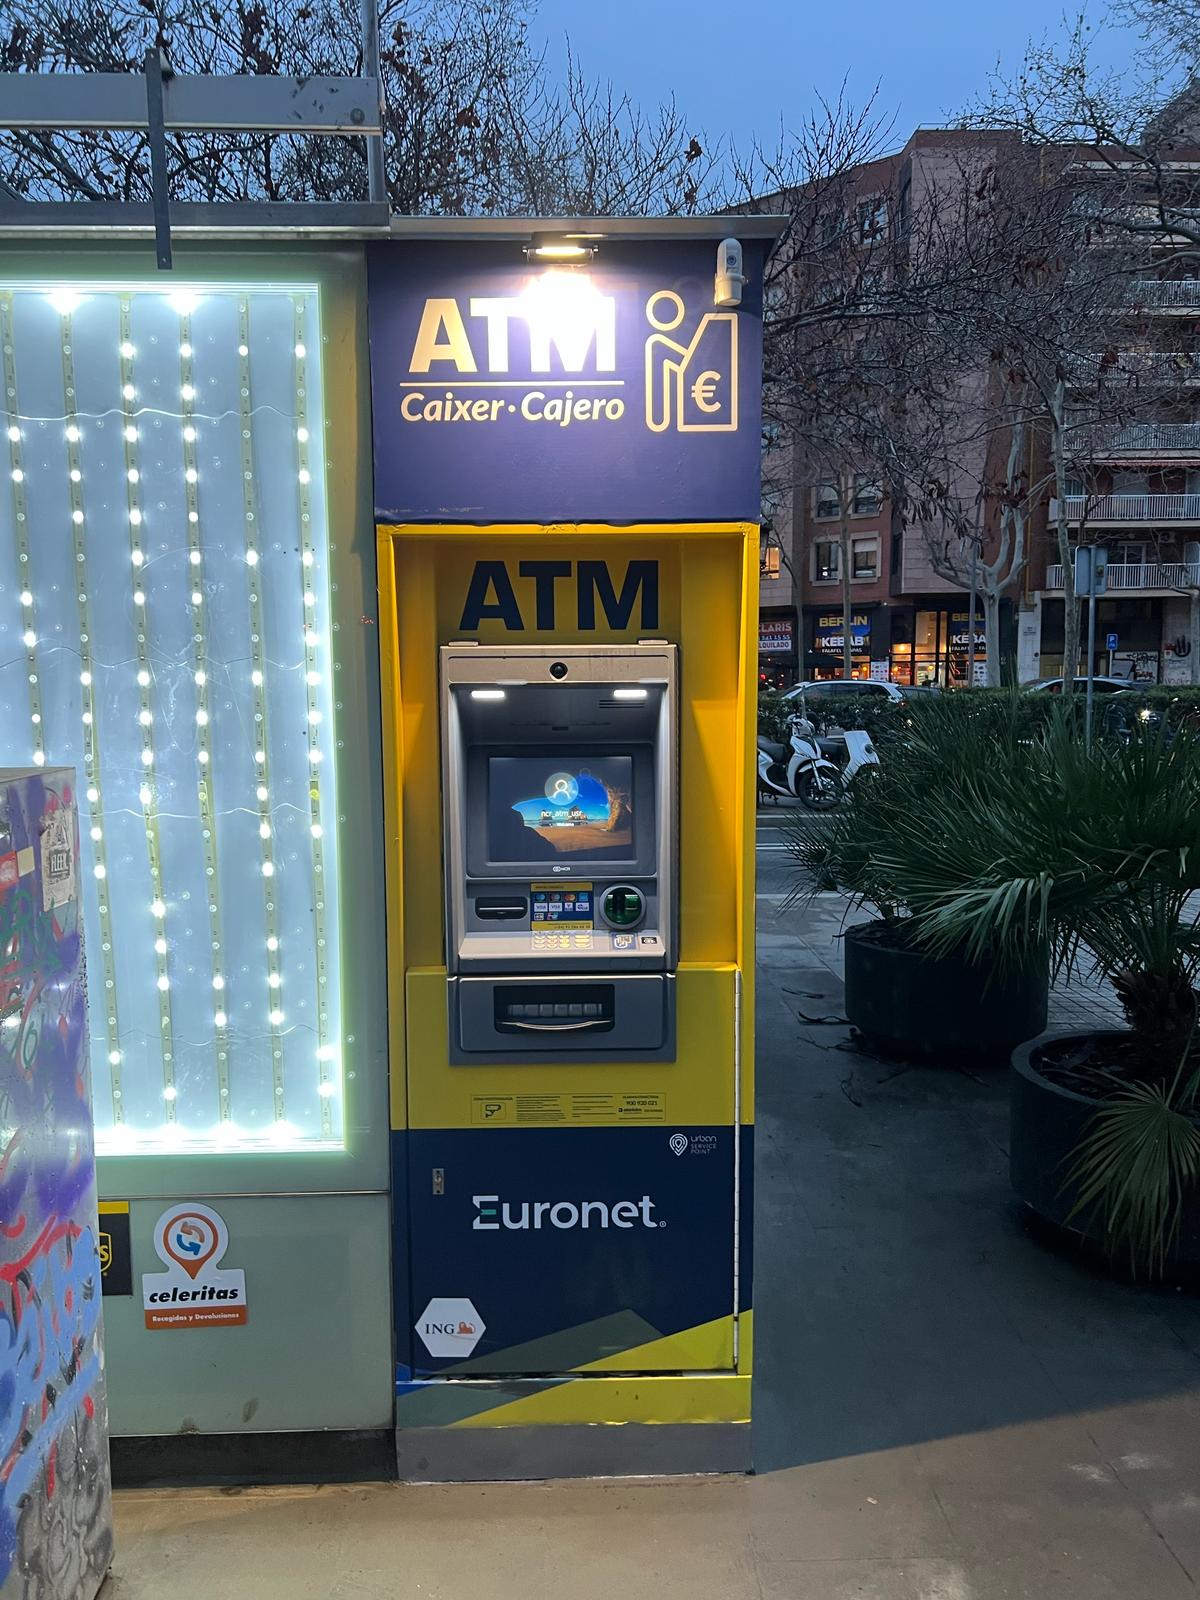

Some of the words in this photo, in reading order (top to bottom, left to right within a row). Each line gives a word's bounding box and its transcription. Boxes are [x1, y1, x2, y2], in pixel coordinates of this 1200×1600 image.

[409, 297, 615, 373] ATM
[459, 560, 659, 631] ATM
[472, 1195, 658, 1230] Euronet
[149, 1286, 238, 1303] celeritas
[425, 1323, 455, 1335] ING
